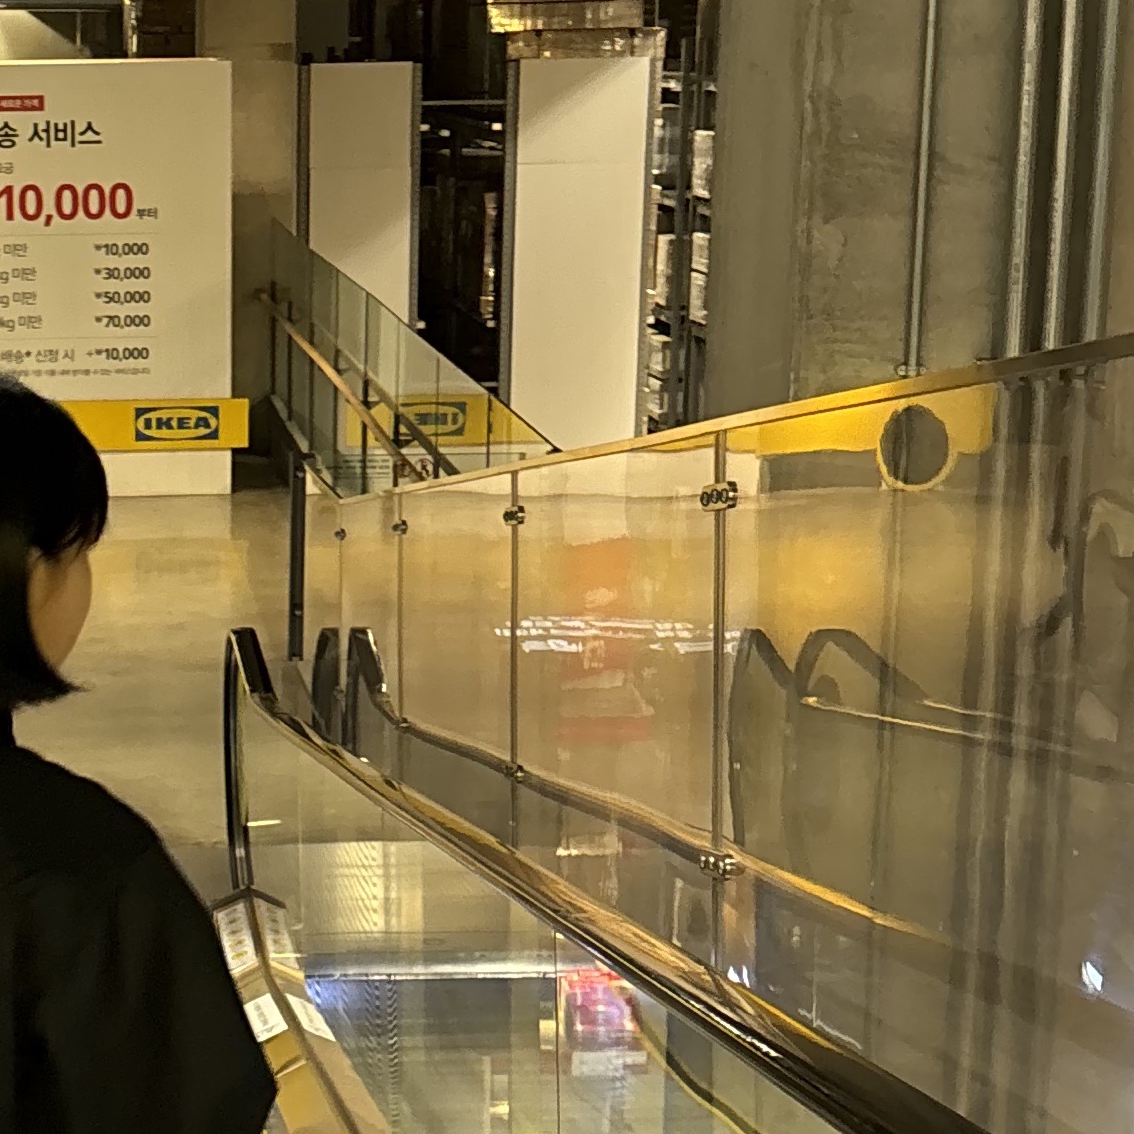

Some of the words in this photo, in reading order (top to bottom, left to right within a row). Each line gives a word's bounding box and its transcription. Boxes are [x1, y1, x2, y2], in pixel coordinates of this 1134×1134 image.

[28, 120, 103, 148] 서비스
[136, 207, 158, 219] 부터
[3, 243, 28, 257] 미만
[11, 267, 37, 281] 미만
[12, 291, 37, 305] 미만
[18, 315, 43, 329] 미만
[144, 416, 211, 430] IKEA
